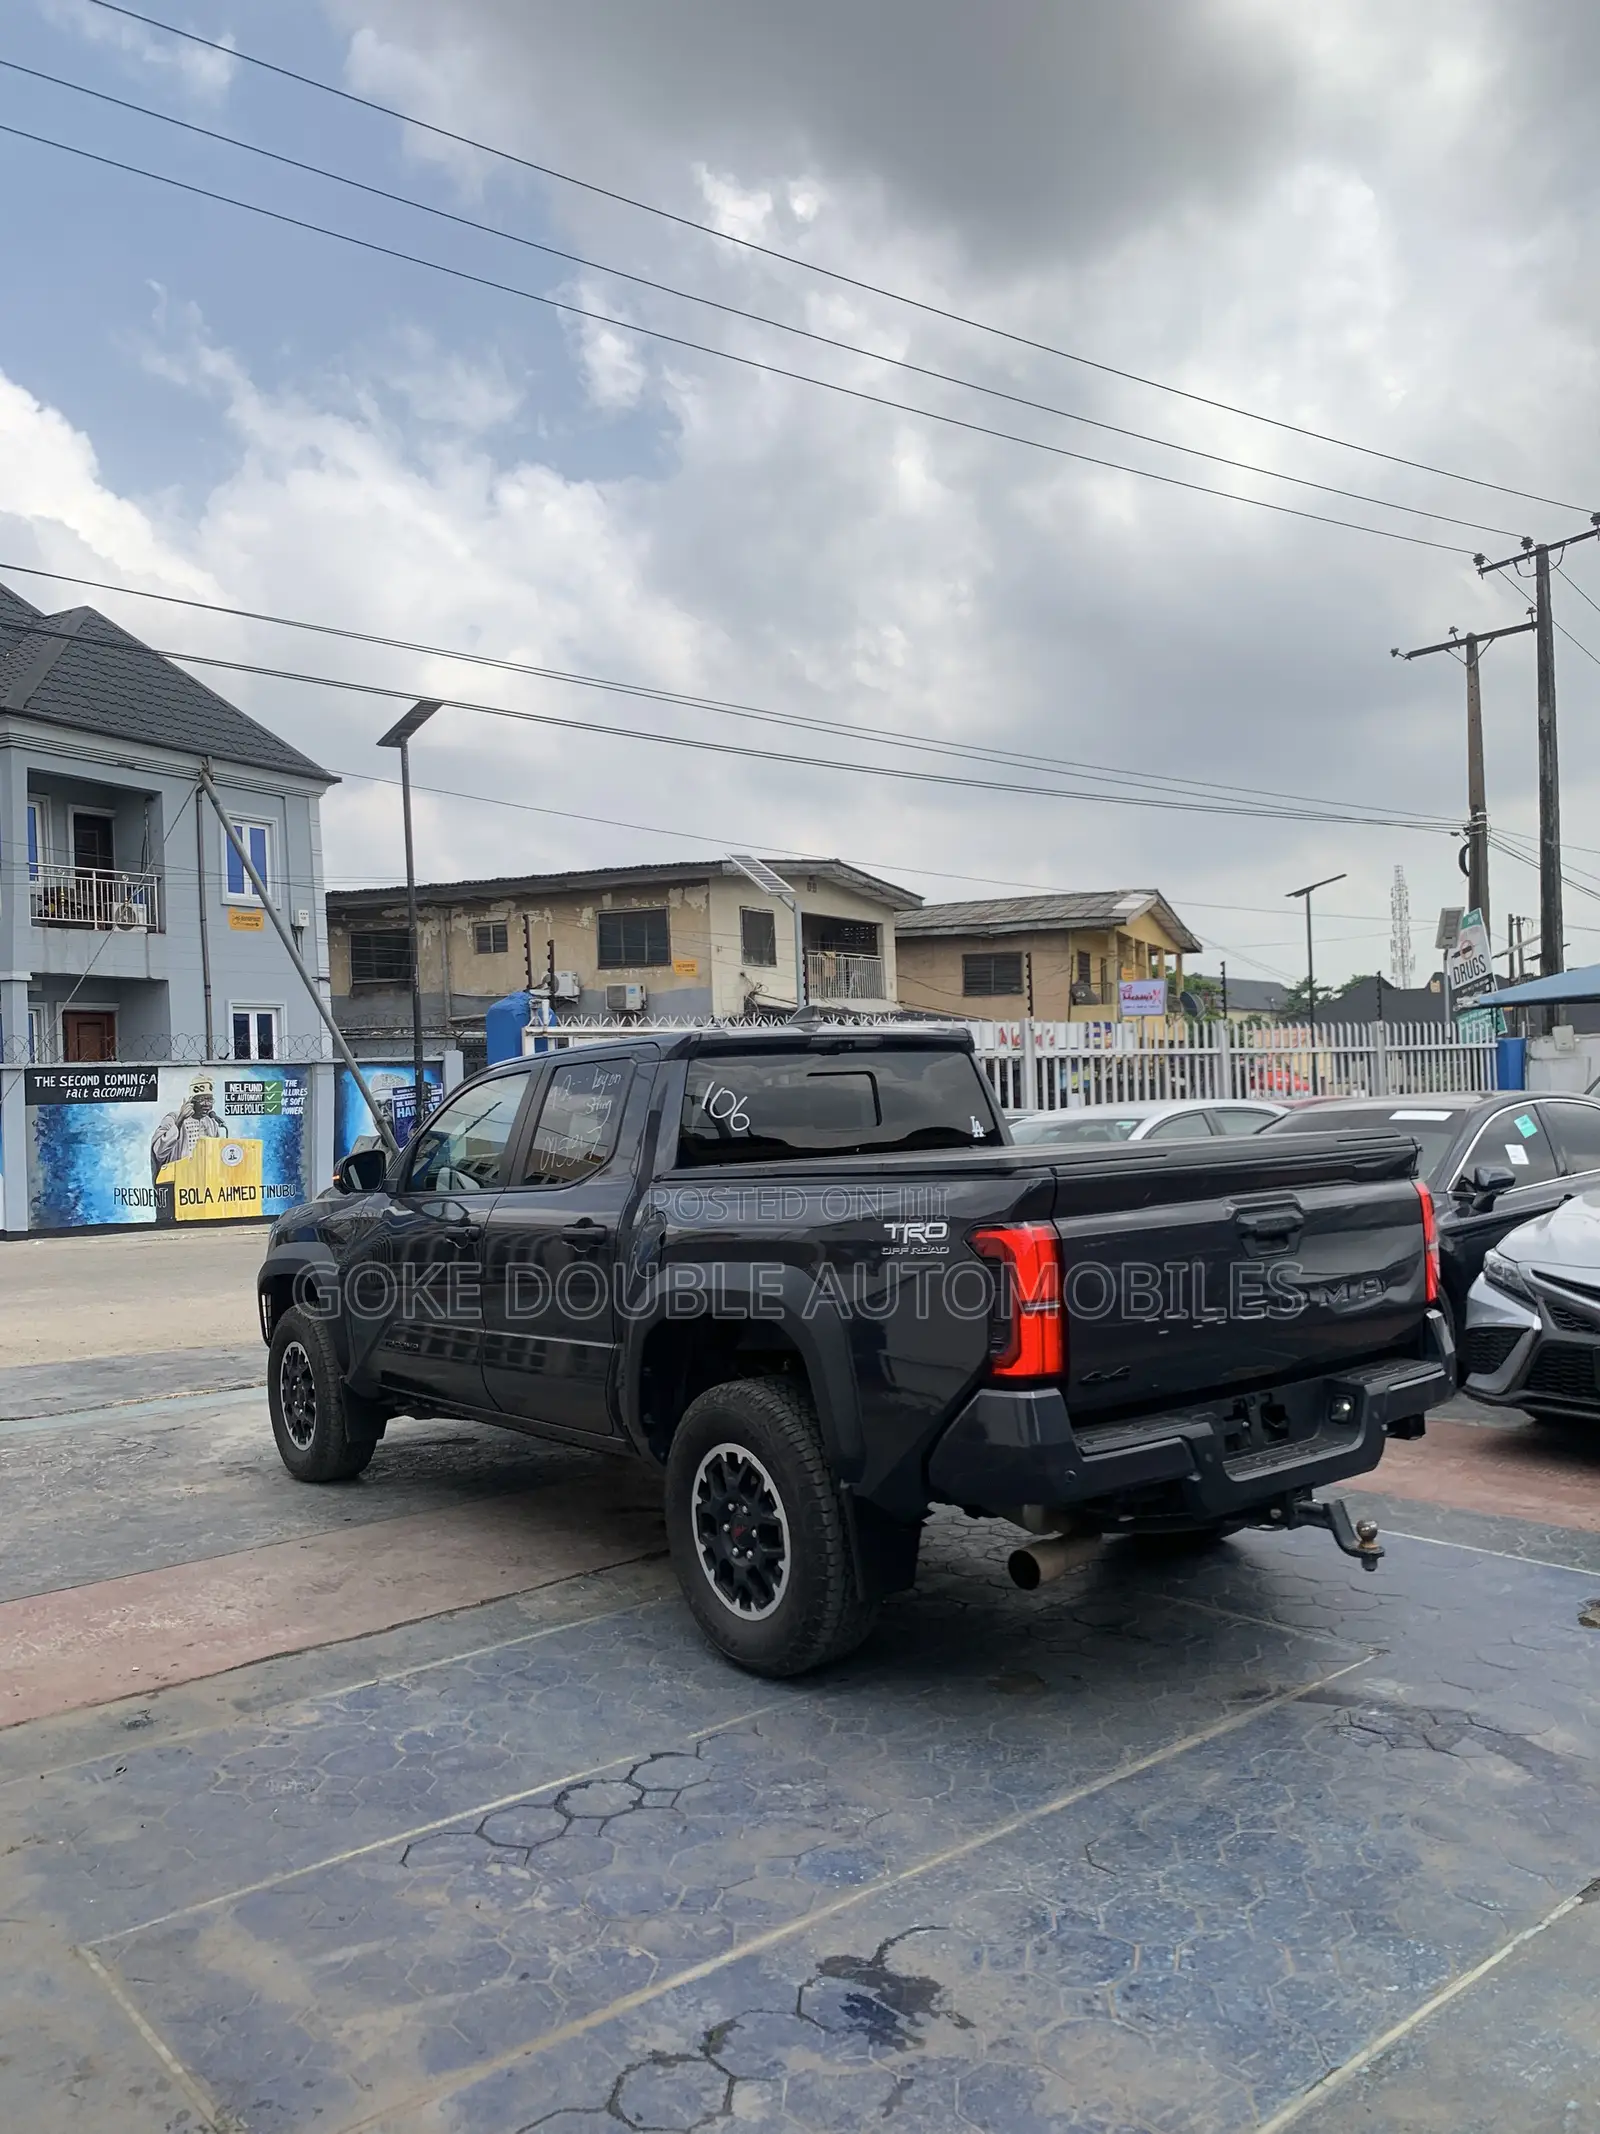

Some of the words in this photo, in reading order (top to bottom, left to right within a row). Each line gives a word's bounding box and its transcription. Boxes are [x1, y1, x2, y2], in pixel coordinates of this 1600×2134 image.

[1453, 954, 1487, 985] DRUGS
[34, 1076, 56, 1087] THE
[59, 1075, 100, 1087] SECOND
[281, 1098, 289, 1106] OF
[290, 1097, 305, 1106] SOFT
[281, 1106, 304, 1115] POWER
[701, 1081, 750, 1131] 106
[113, 1187, 169, 1208] PRESIDENT
[179, 1187, 215, 1206] BOLA
[217, 1185, 256, 1203] AHMED
[259, 1183, 297, 1199] TINUBU
[883, 1222, 949, 1244] TRD
